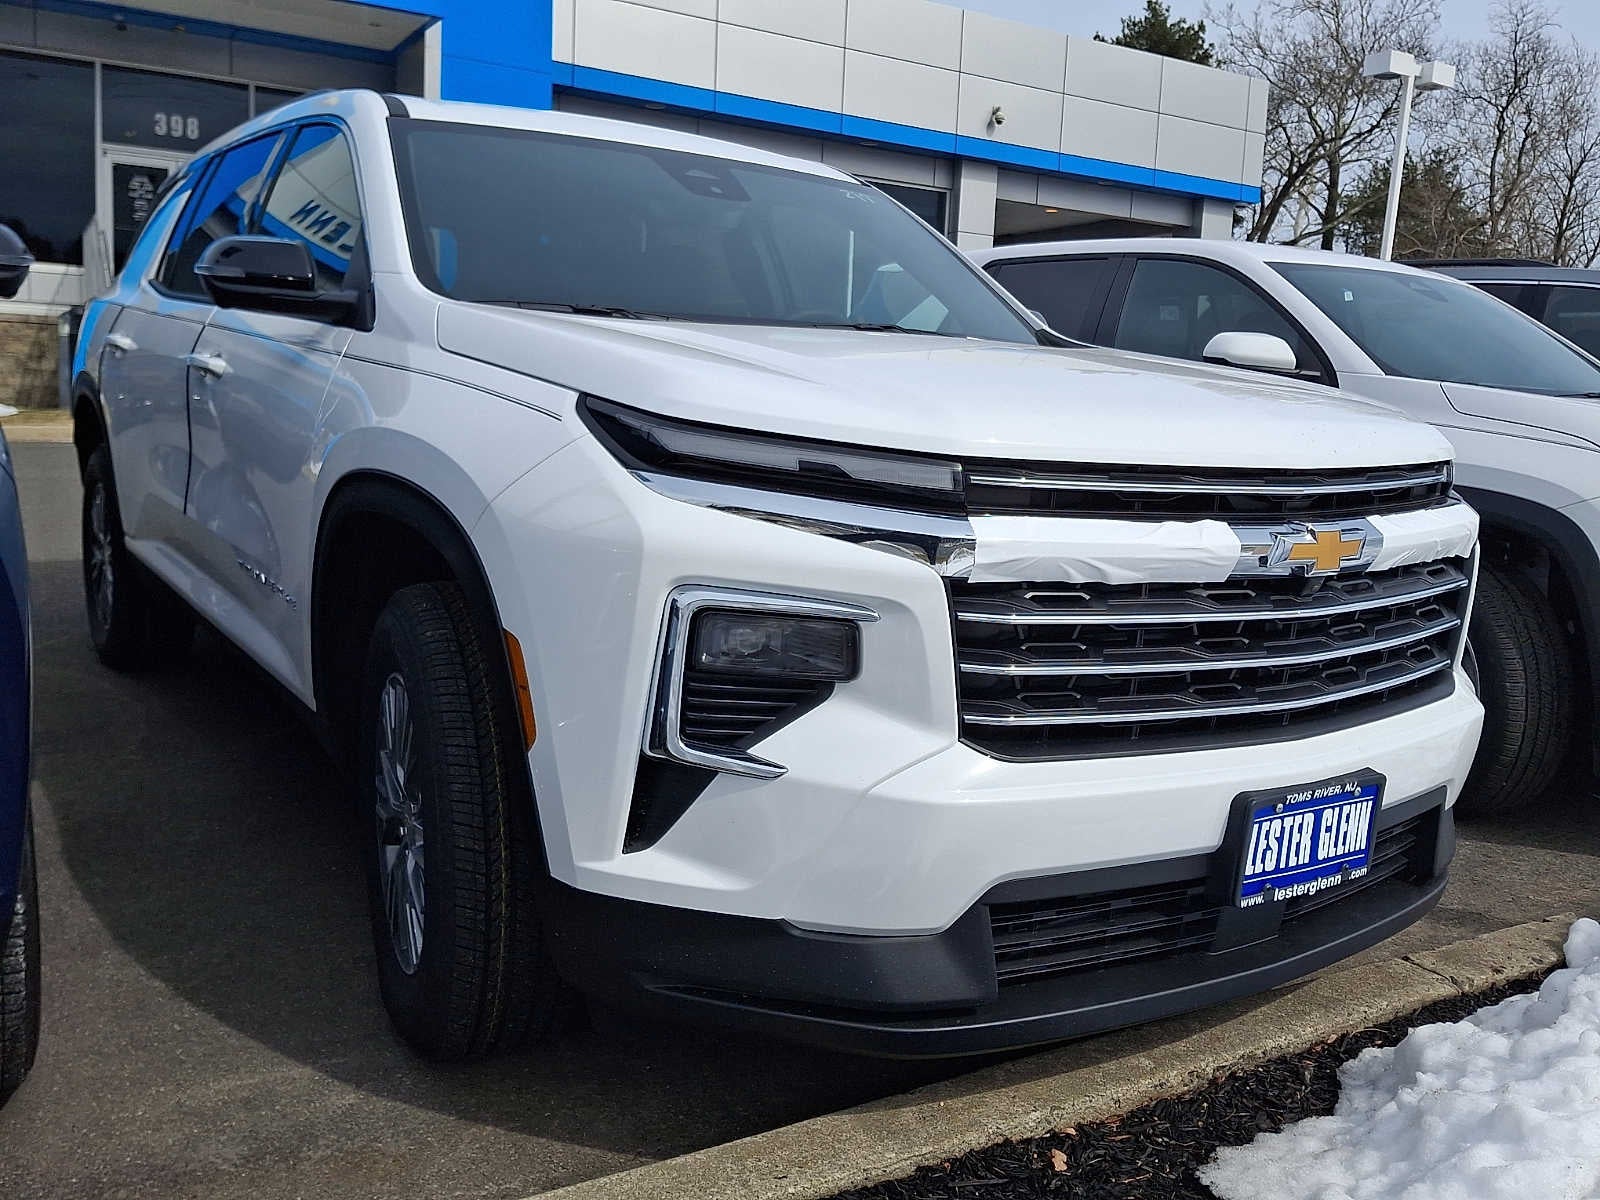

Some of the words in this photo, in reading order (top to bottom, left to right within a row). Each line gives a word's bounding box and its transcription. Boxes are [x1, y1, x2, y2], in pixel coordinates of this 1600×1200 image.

[154, 112, 199, 140] 398
[1286, 791, 1313, 805] TOMS
[1344, 781, 1358, 793] NJ
[1245, 812, 1315, 876] LESTER
[1317, 800, 1373, 861] GLENN
[1274, 874, 1342, 901] lesterglenn
